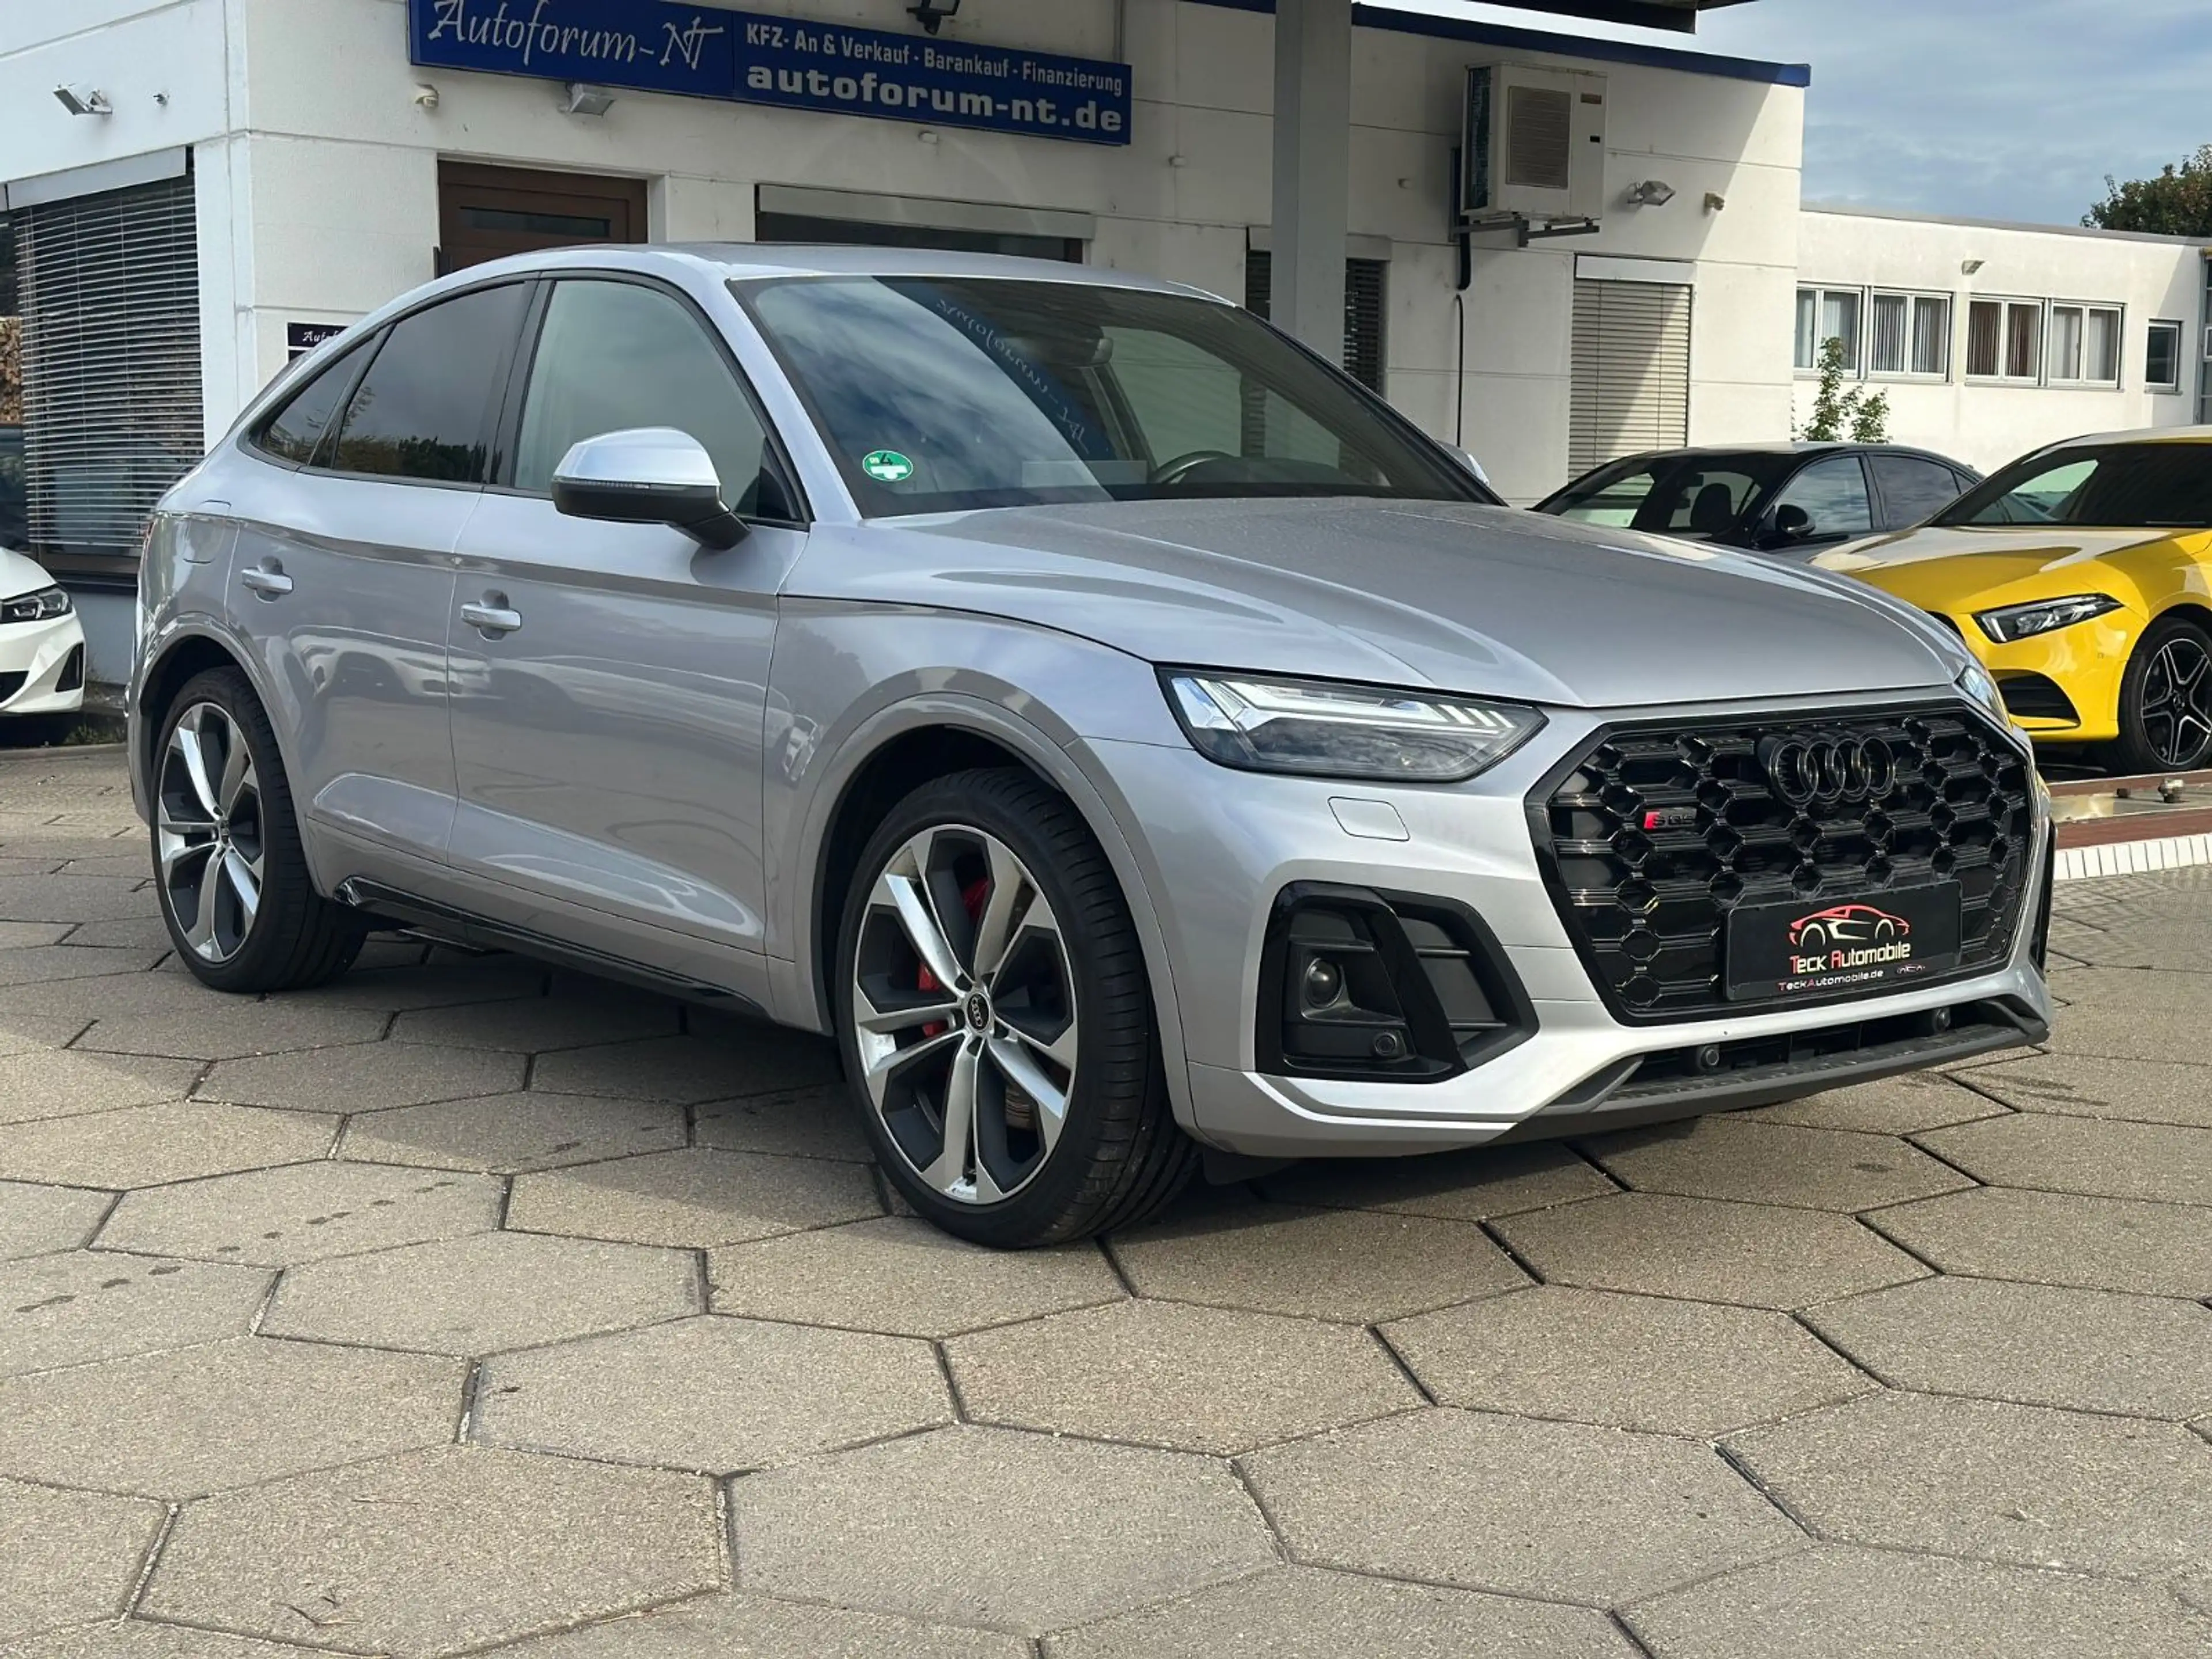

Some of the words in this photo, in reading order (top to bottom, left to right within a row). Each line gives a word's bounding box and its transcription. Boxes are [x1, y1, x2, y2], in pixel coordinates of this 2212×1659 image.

[428, 0, 724, 70] Autoforum-NT
[794, 29, 817, 52] An
[823, 33, 836, 55] &
[841, 35, 910, 65] Verkauf
[924, 47, 1009, 78] Barankauf
[1022, 60, 1122, 97] Finanzierung
[747, 65, 1122, 131] autoforum-nt.de
[880, 453, 893, 465] 4
[1778, 969, 1884, 991] TeckAutomobile.de
